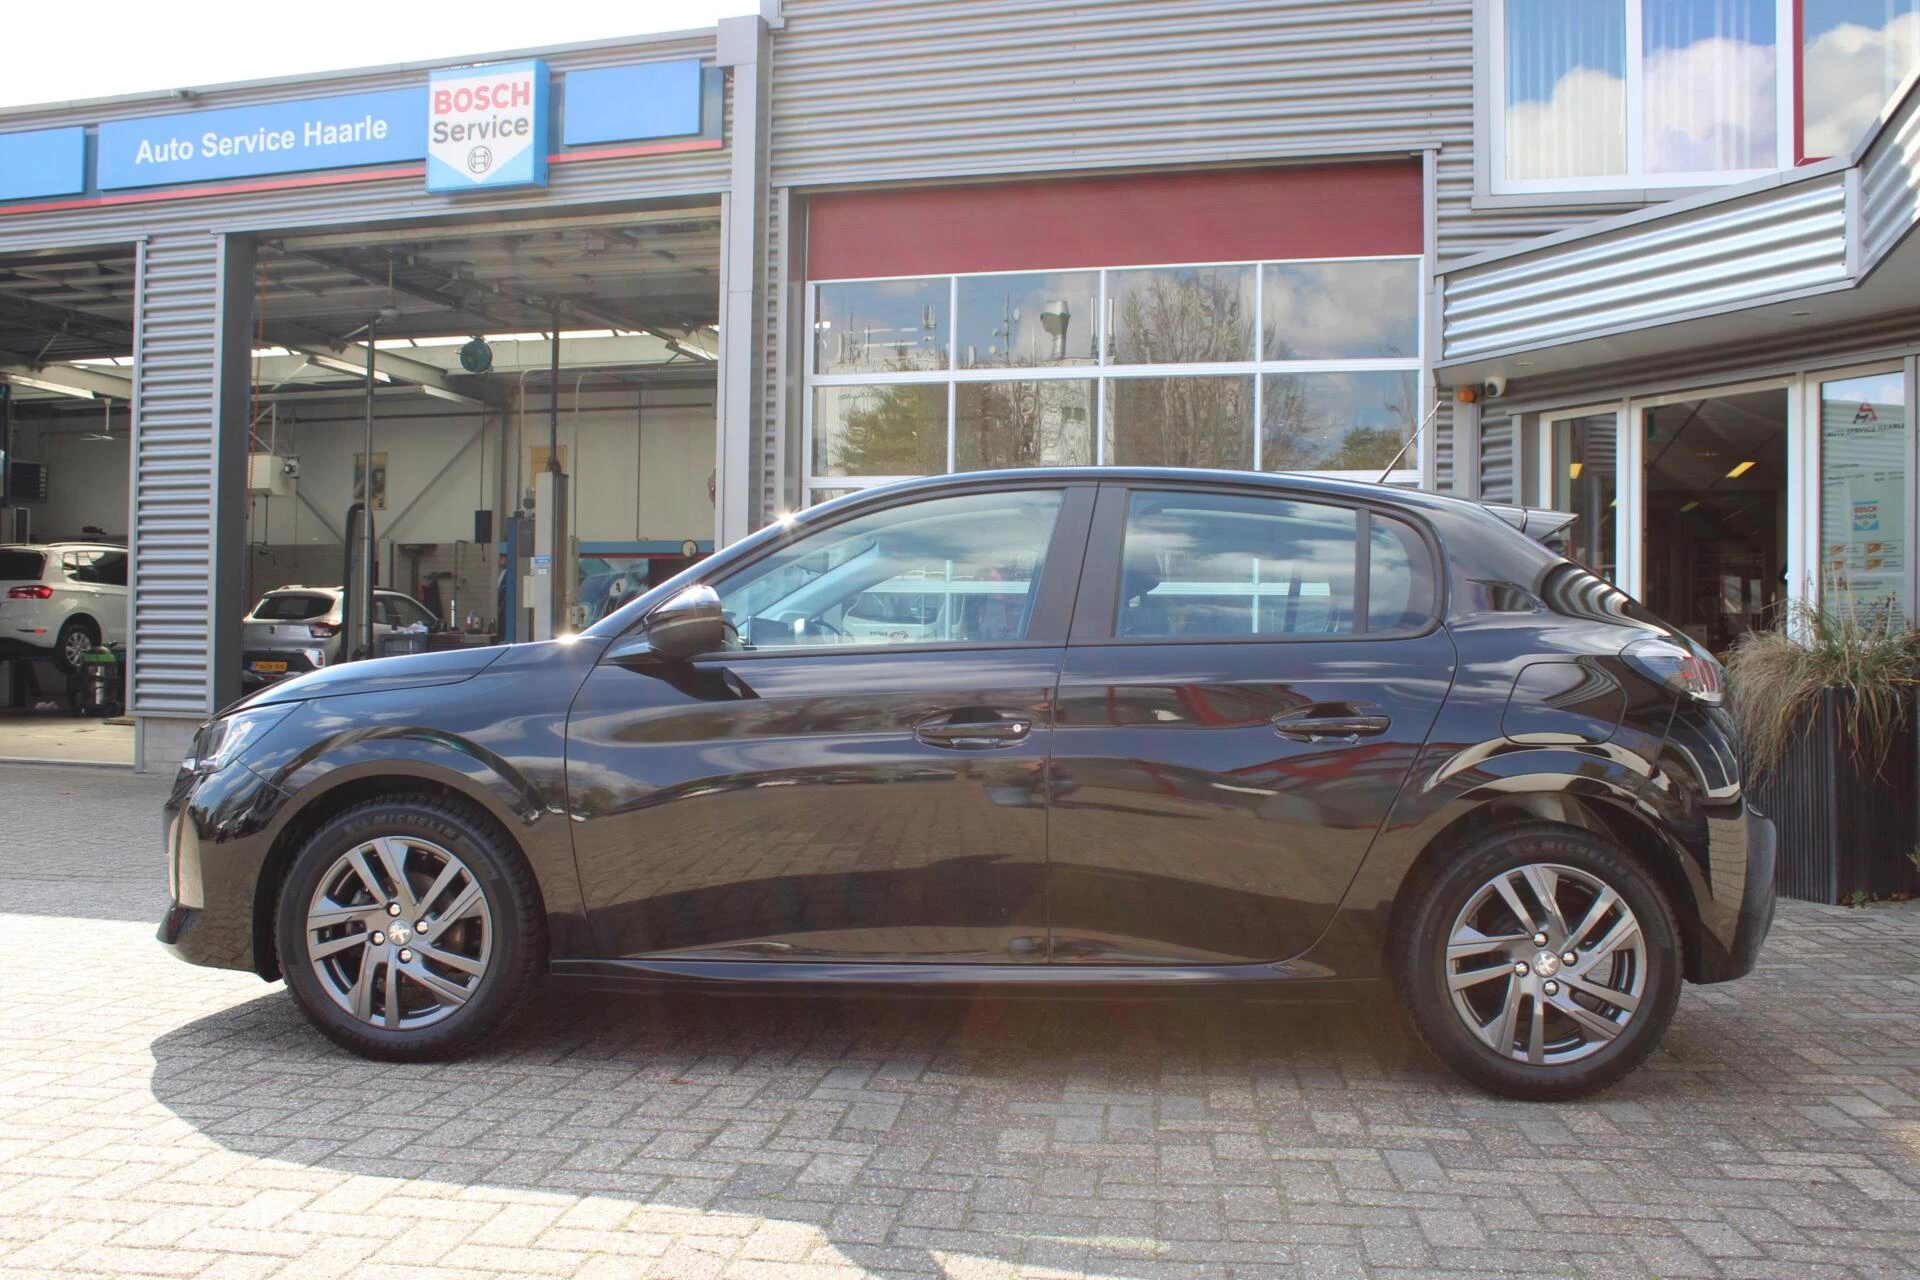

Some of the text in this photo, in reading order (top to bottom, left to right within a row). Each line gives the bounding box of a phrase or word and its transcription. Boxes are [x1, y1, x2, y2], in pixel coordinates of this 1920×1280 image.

[434, 81, 530, 115] BOSCH
[135, 114, 388, 164] Auto Service Haarle
[432, 114, 529, 144] Service
[1854, 505, 1878, 513] BOSCH
[373, 814, 459, 841] MICHELIN
[1541, 840, 1628, 877] MICHELIN
